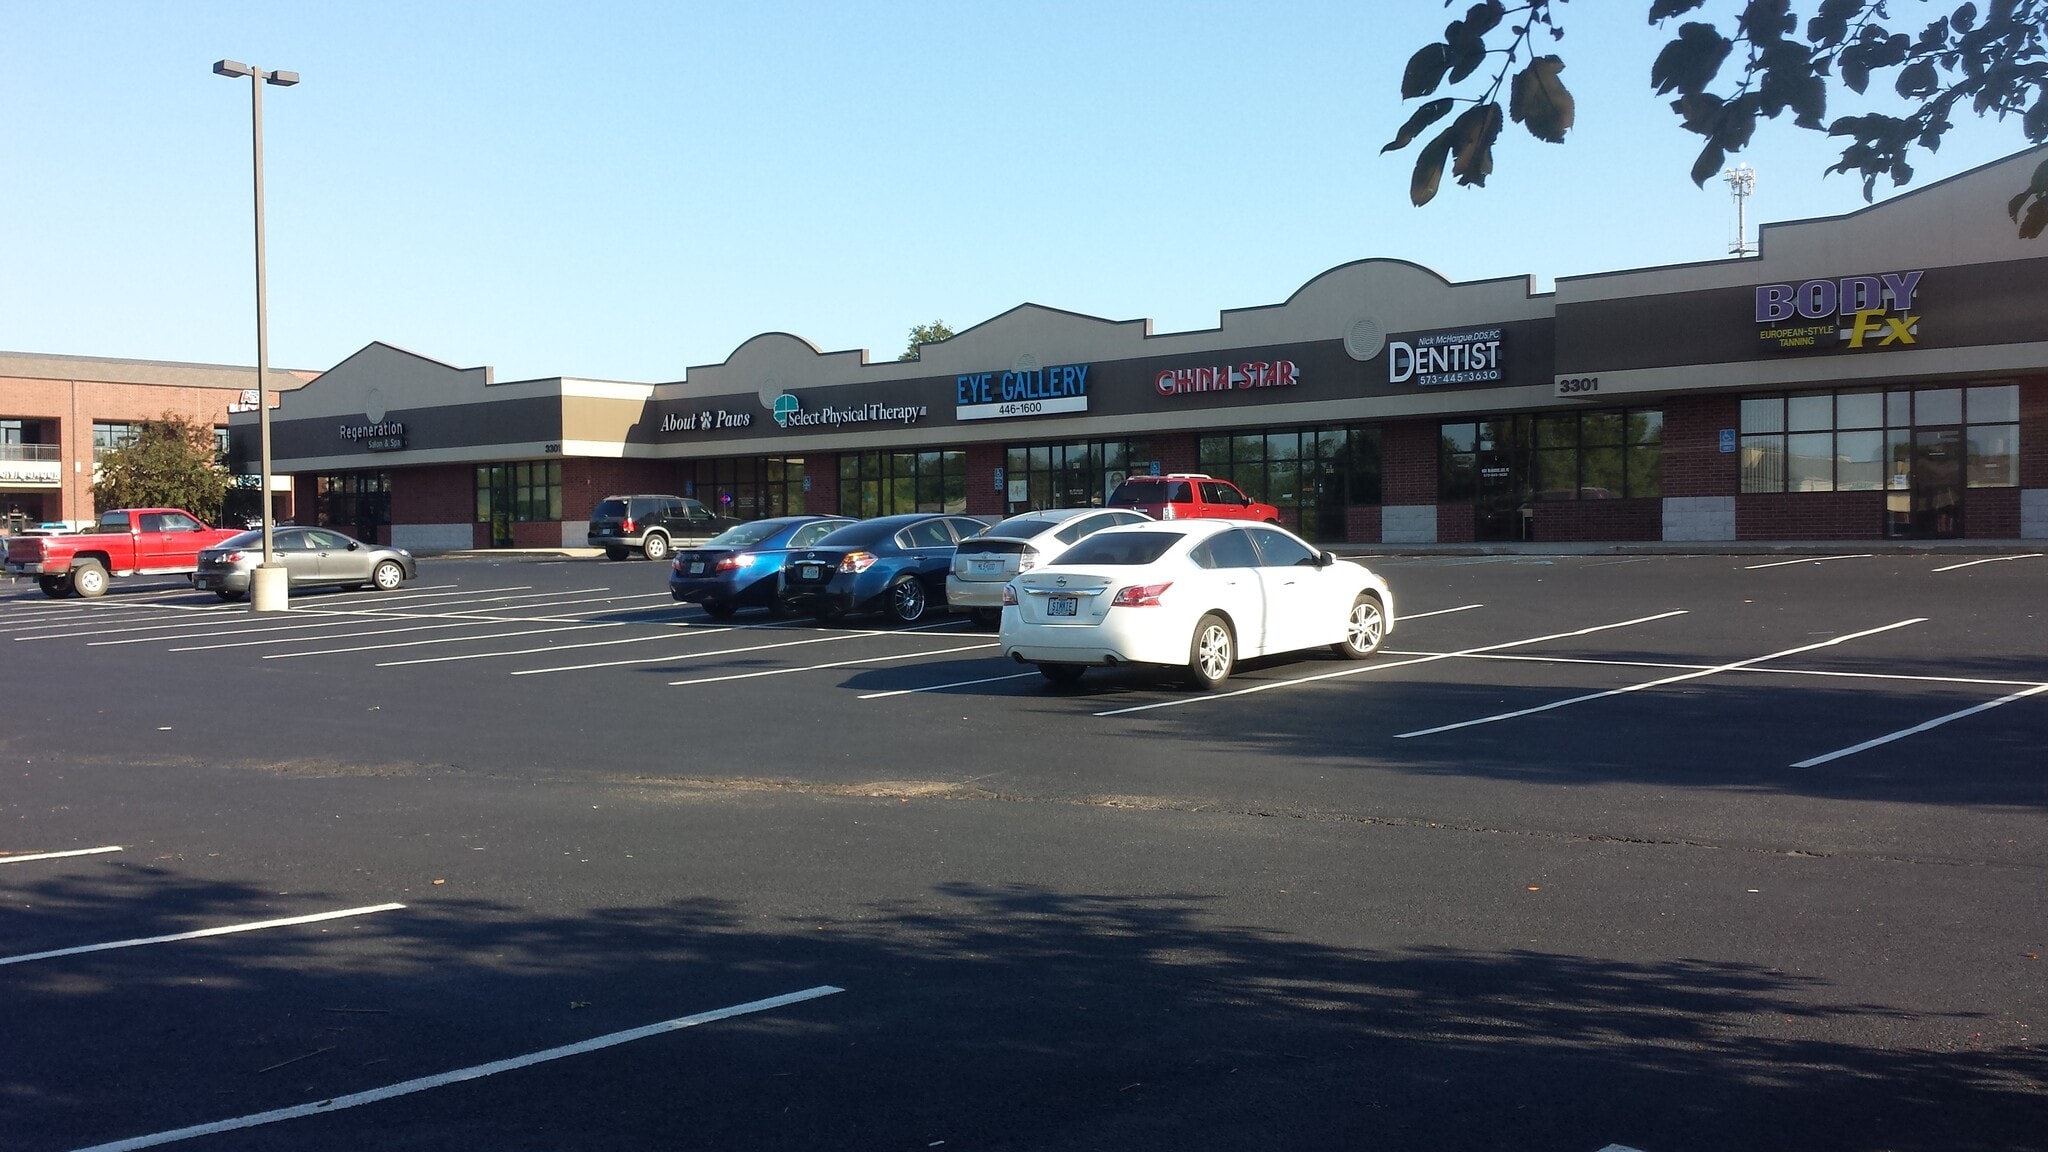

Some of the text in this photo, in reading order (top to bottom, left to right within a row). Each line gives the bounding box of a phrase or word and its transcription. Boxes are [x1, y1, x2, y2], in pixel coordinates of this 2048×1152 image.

[1755, 270, 1925, 323] BODY
[1760, 325, 1834, 340] EUROPEAN-STYLE
[1418, 337, 1434, 346] Nick
[1779, 336, 1815, 347] TANNING
[1389, 341, 1500, 383] DENTIST
[957, 365, 1090, 404] EYE GALLERY
[1155, 360, 1299, 397] CHINA STAR
[1420, 370, 1498, 385] 573-445-3630
[1560, 377, 1599, 393] 3301
[788, 404, 923, 427] Select Physical Therapy
[999, 402, 1042, 415] 446-1600
[660, 410, 751, 432] About Paws
[340, 421, 403, 442] Regeneration
[368, 440, 383, 449] Salon
[390, 438, 402, 448] Spa
[545, 444, 561, 453] 3301
